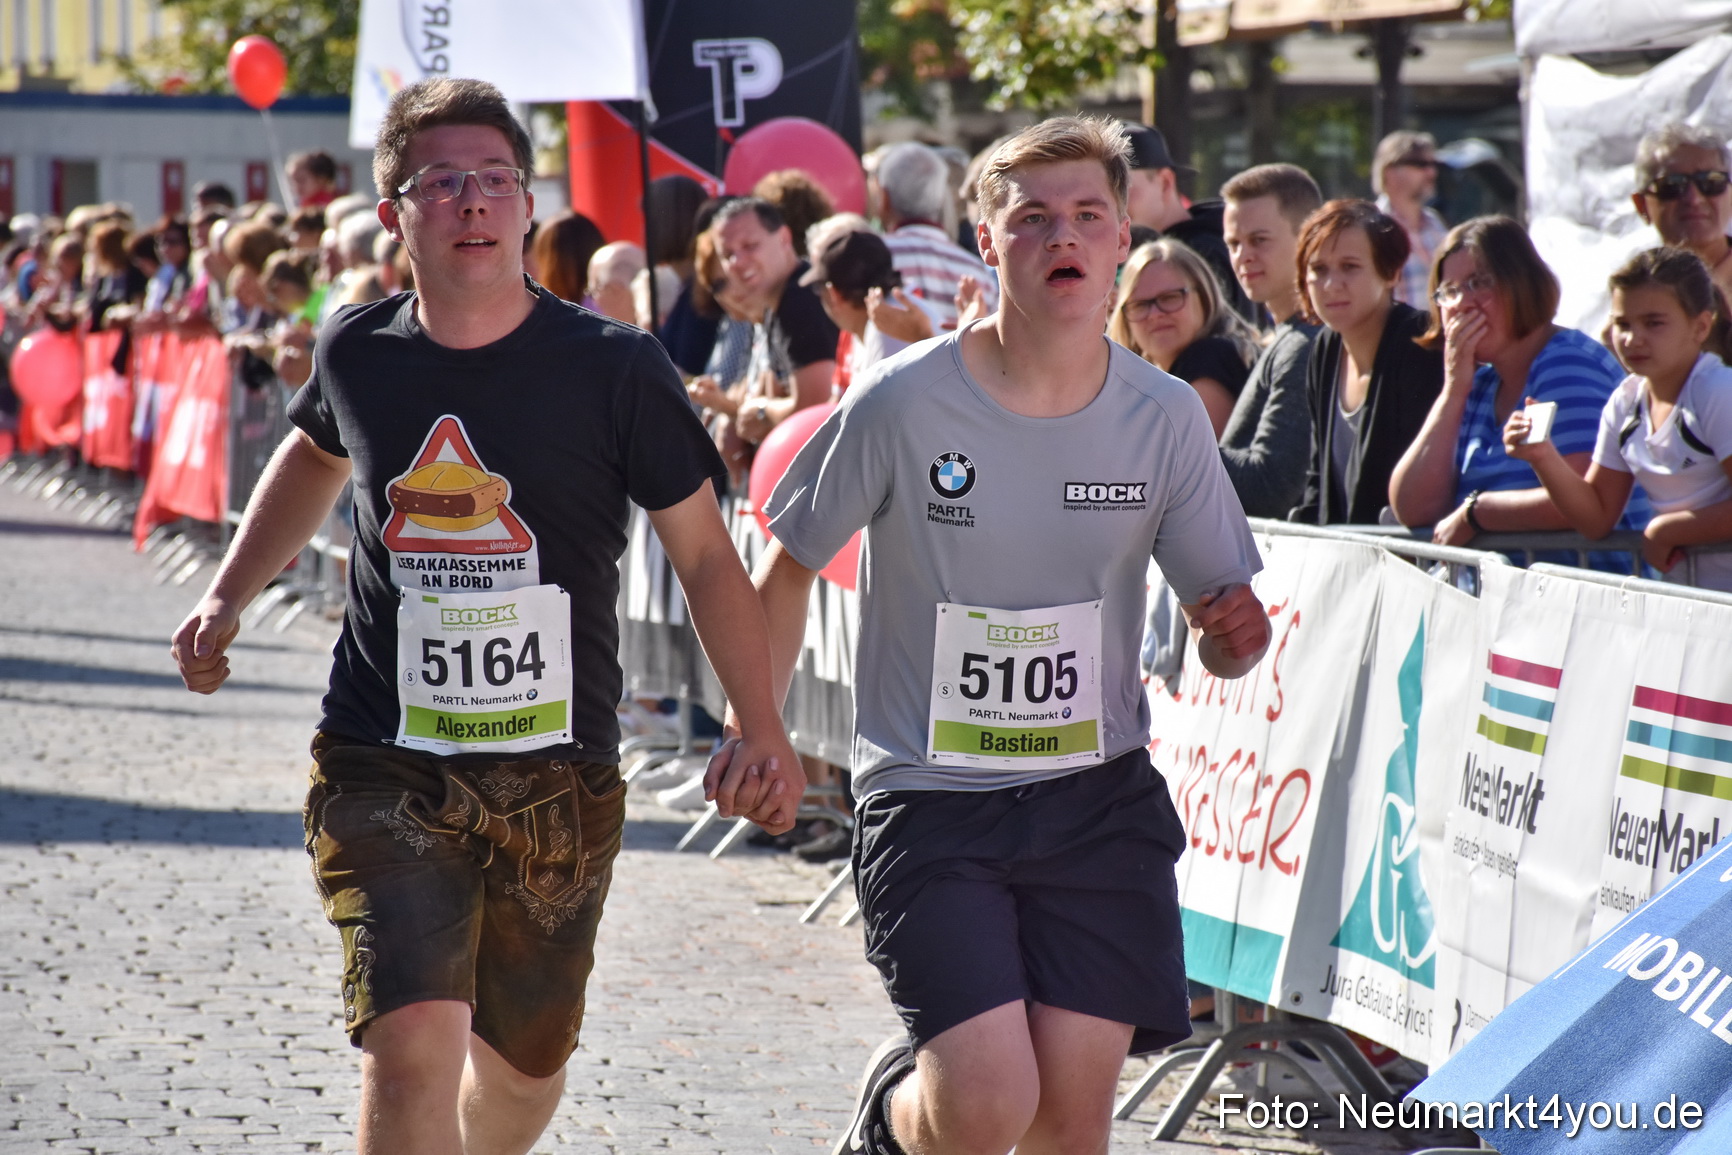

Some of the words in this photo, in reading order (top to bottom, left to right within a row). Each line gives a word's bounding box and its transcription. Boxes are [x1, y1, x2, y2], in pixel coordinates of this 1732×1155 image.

[1064, 482, 1147, 503] BOCK
[927, 502, 975, 519] PARTL
[1063, 503, 1092, 512] inspired
[1092, 503, 1101, 512] by
[927, 513, 975, 528] Neumarkt
[421, 574, 442, 588] AN
[449, 575, 493, 589] BORD
[441, 603, 518, 625] BOCK
[987, 622, 1060, 643] BOCK
[421, 631, 546, 688] 5164
[407, 673, 413, 682] S
[959, 650, 1078, 703] 5105
[432, 694, 468, 706] PARTL
[471, 693, 523, 706] Neumarkt
[942, 686, 949, 695] S
[969, 708, 1005, 720] PARTL
[1009, 711, 1058, 721] Neumarkt
[435, 715, 537, 739] Alexander
[980, 731, 1058, 752] Bastian
[1320, 964, 1353, 1001] Jura
